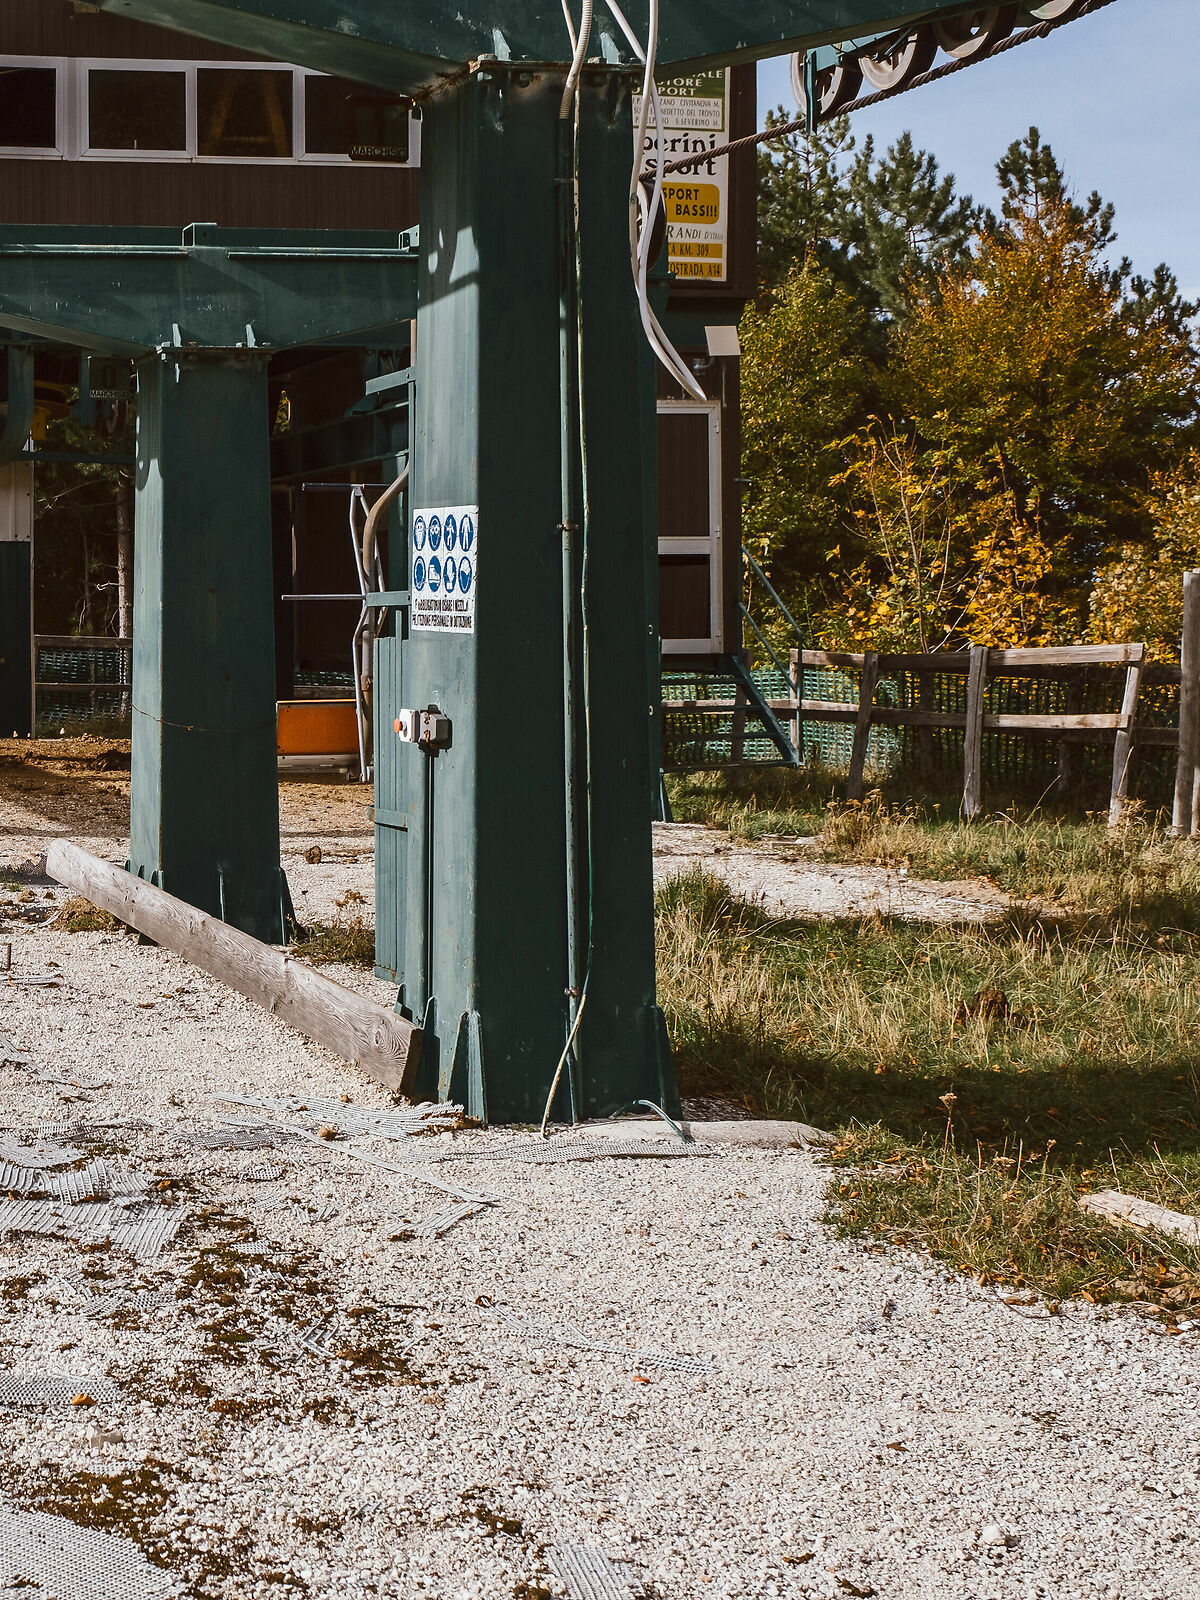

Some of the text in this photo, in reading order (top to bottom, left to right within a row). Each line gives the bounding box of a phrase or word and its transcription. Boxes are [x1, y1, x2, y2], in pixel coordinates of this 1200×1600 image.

[686, 109, 696, 117] DEL
[698, 109, 720, 118] TRONTO
[662, 187, 699, 200] SPORT
[697, 244, 709, 257] 309
[668, 262, 720, 277] OSTRADA A14
